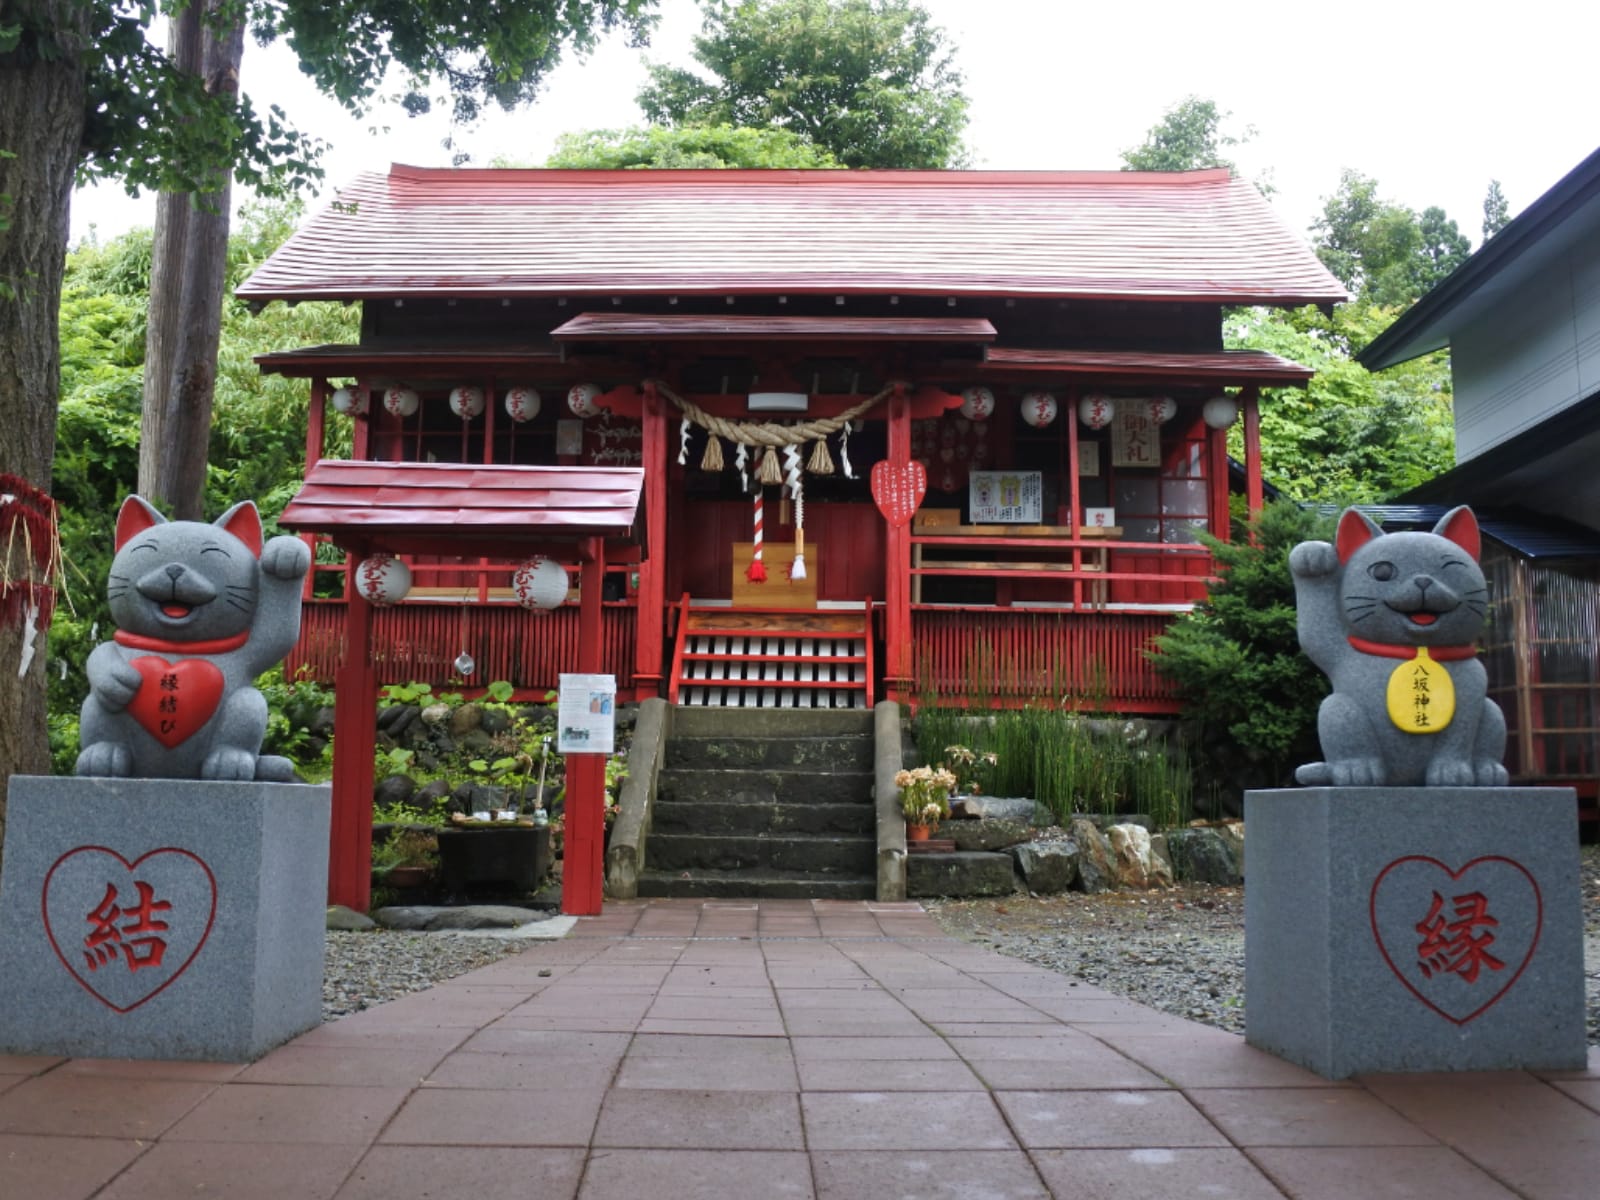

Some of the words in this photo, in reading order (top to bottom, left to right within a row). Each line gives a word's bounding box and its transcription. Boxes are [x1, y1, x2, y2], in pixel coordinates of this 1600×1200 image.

[159, 673, 180, 734] 縁結び
[1412, 664, 1431, 727] 八坂神社
[82, 880, 173, 974] 結
[1415, 889, 1506, 986] 縁
